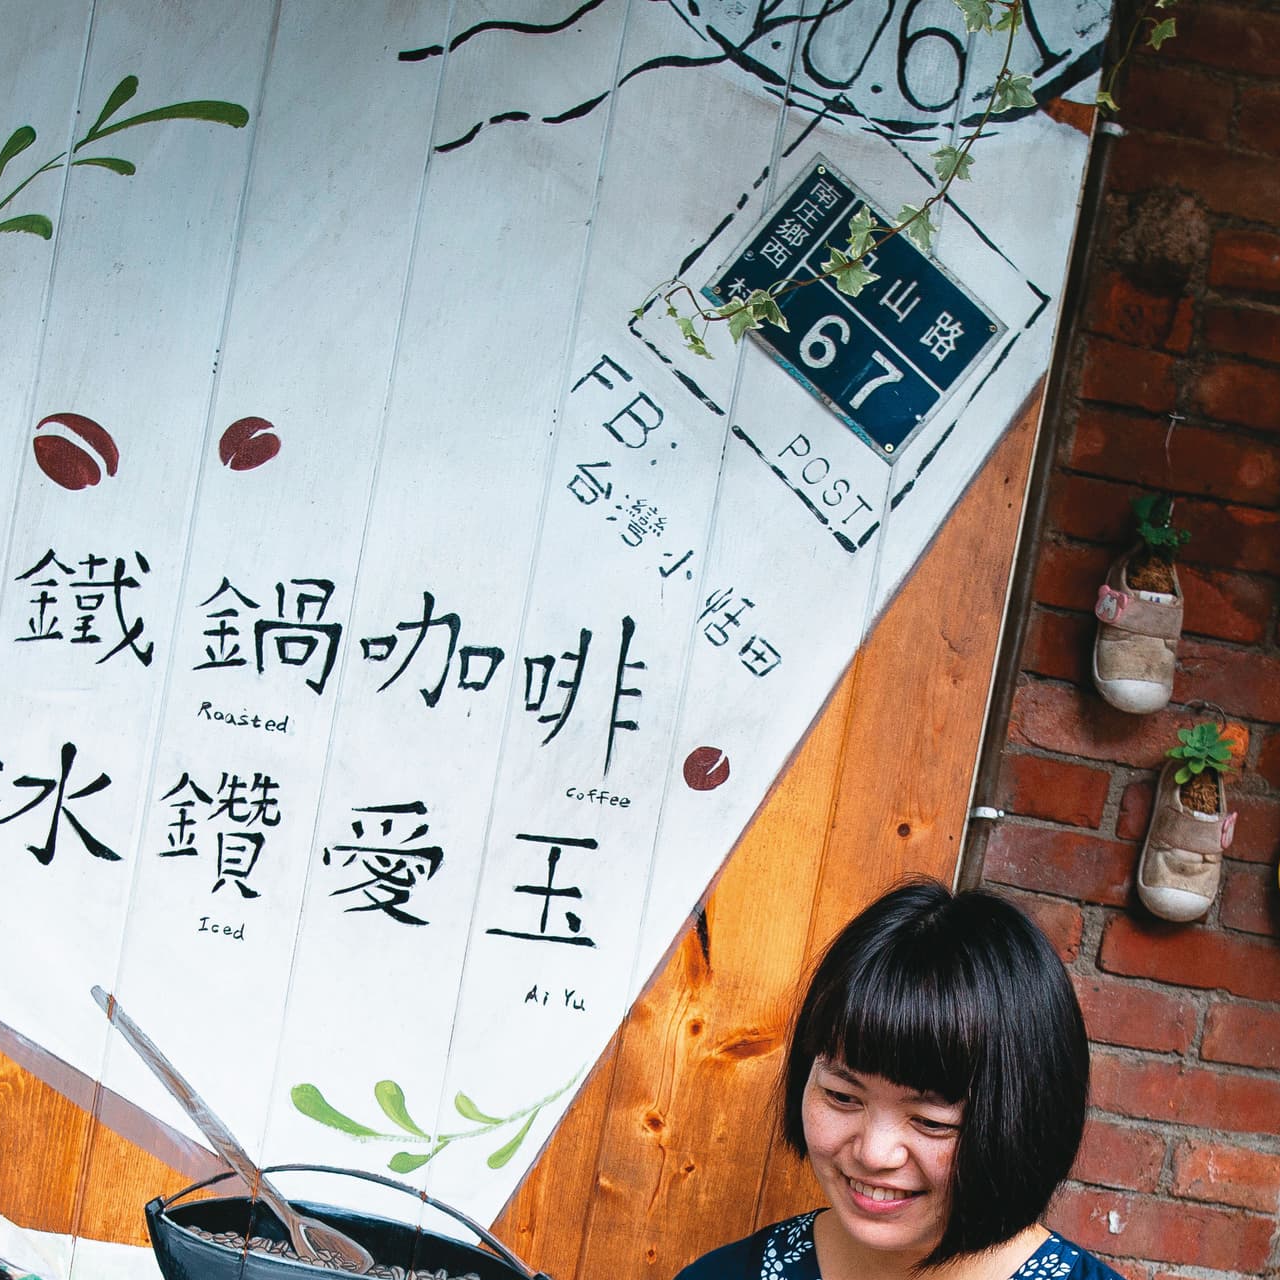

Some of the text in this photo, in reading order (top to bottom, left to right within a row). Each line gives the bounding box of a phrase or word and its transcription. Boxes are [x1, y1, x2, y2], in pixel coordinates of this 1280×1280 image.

[846, 240, 964, 362] 山路
[799, 314, 904, 410] 67
[777, 433, 873, 525] POST
[566, 460, 782, 677] 台灣小恬田
[14, 547, 647, 780] 鐵鍋咖啡
[197, 700, 289, 734] Roasted
[198, 916, 245, 942] Iced
[524, 983, 586, 1012] Ai Yu
